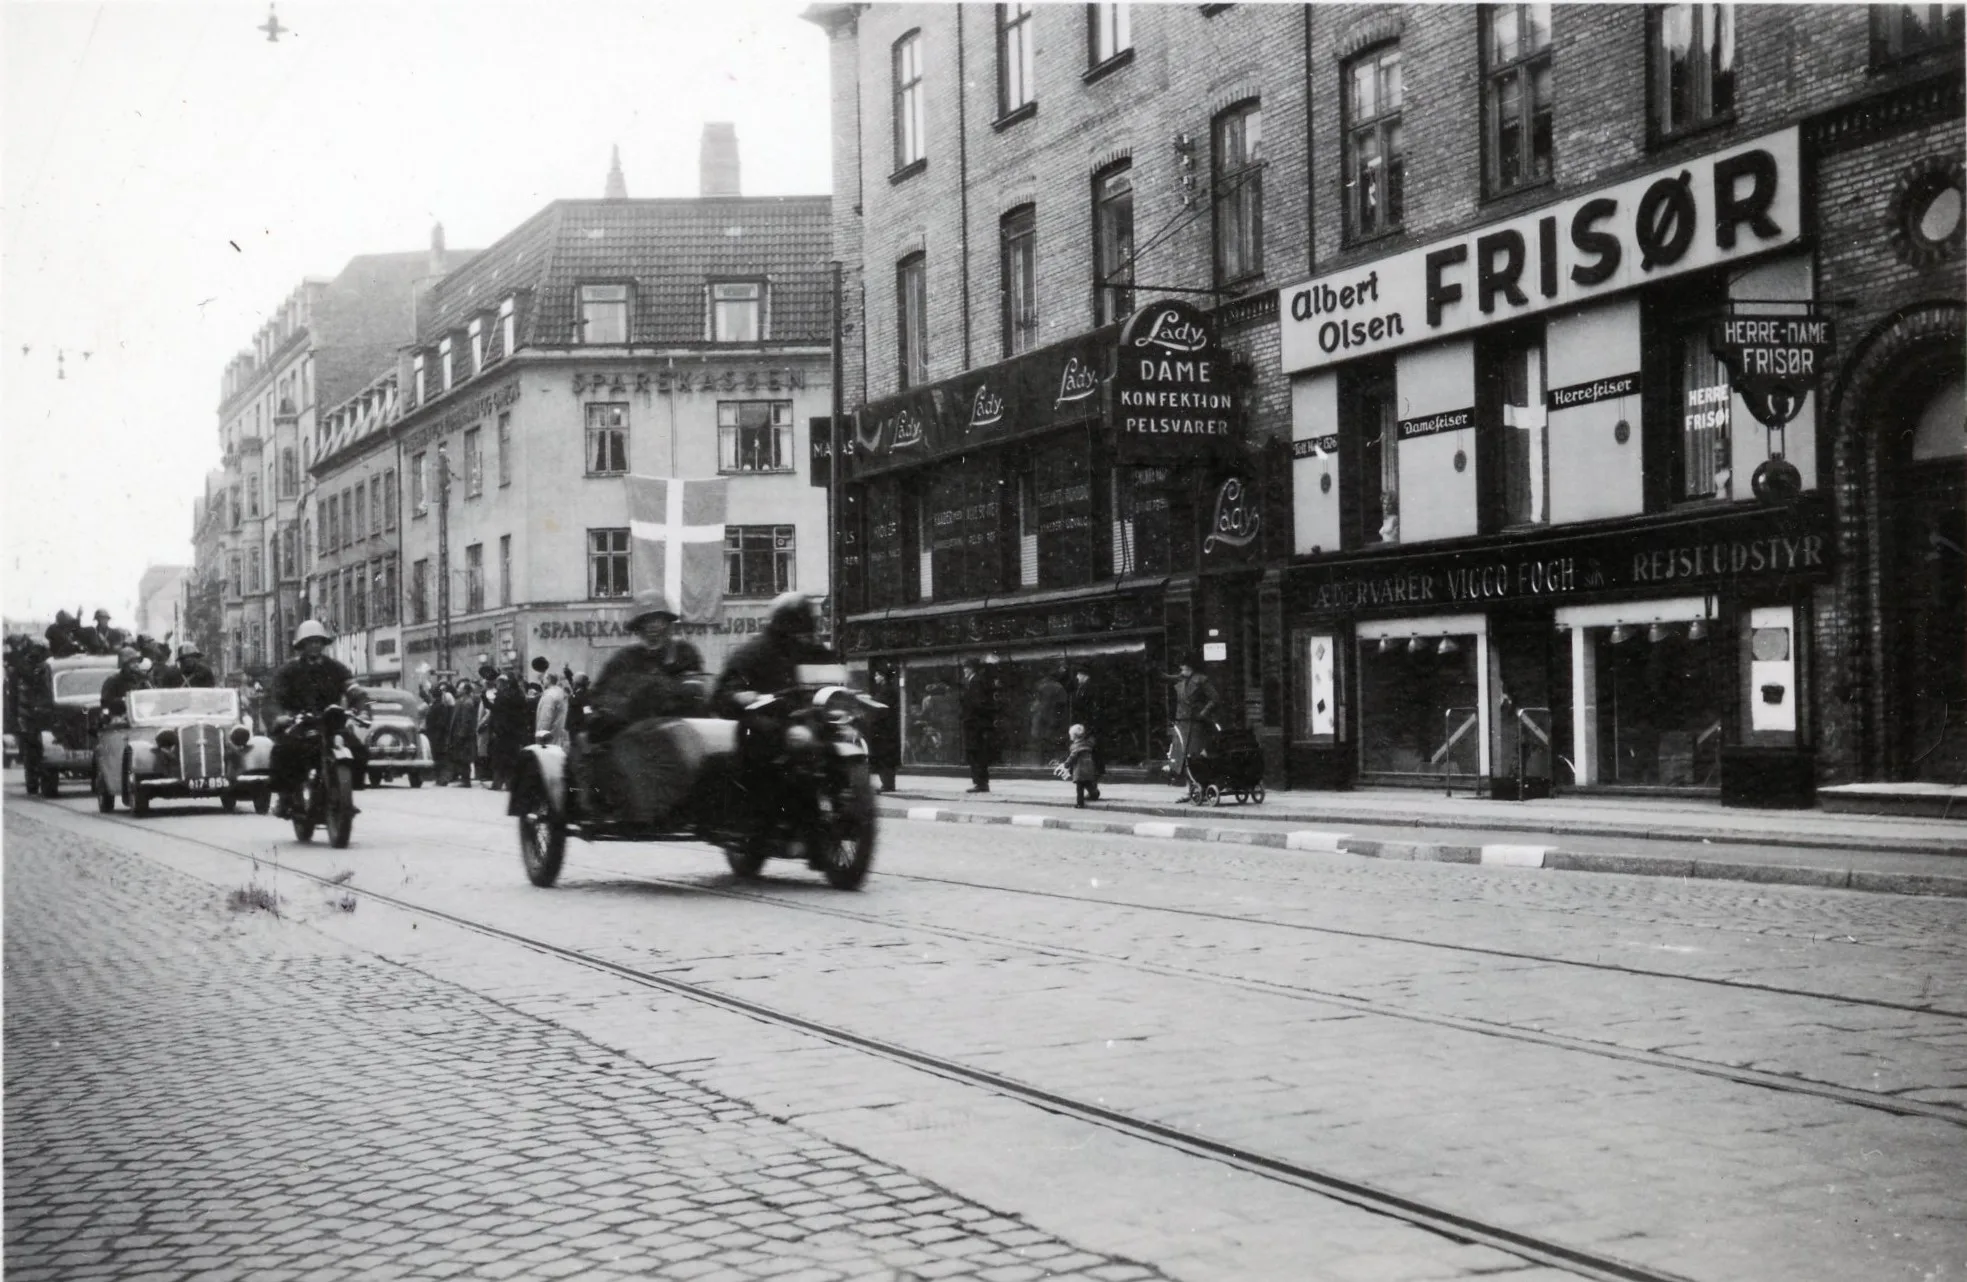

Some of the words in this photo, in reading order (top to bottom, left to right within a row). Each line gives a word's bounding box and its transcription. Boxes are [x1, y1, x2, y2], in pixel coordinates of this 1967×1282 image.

[1425, 149, 1782, 328] FRISØR
[1291, 270, 1378, 322] Albert
[1134, 309, 1207, 352] Lady
[1318, 312, 1404, 354] Olsen
[1725, 320, 1828, 344] HERRE-DAME
[1140, 359, 1212, 383] DAME
[1742, 348, 1814, 375] FRISØR
[1053, 356, 1098, 411] Lady
[1120, 390, 1233, 410] KONFEKTION
[1688, 384, 1729, 406] HERRE
[964, 382, 1004, 435] Lady
[1126, 417, 1229, 435] PELSVARER
[813, 439, 854, 459] MAAS
[887, 409, 923, 455] Lady
[1203, 477, 1260, 555] Lady
[1446, 563, 1509, 600] VIGGO
[1517, 556, 1577, 595] FOGH
[1632, 534, 1824, 583] REJSEUDSTYR
